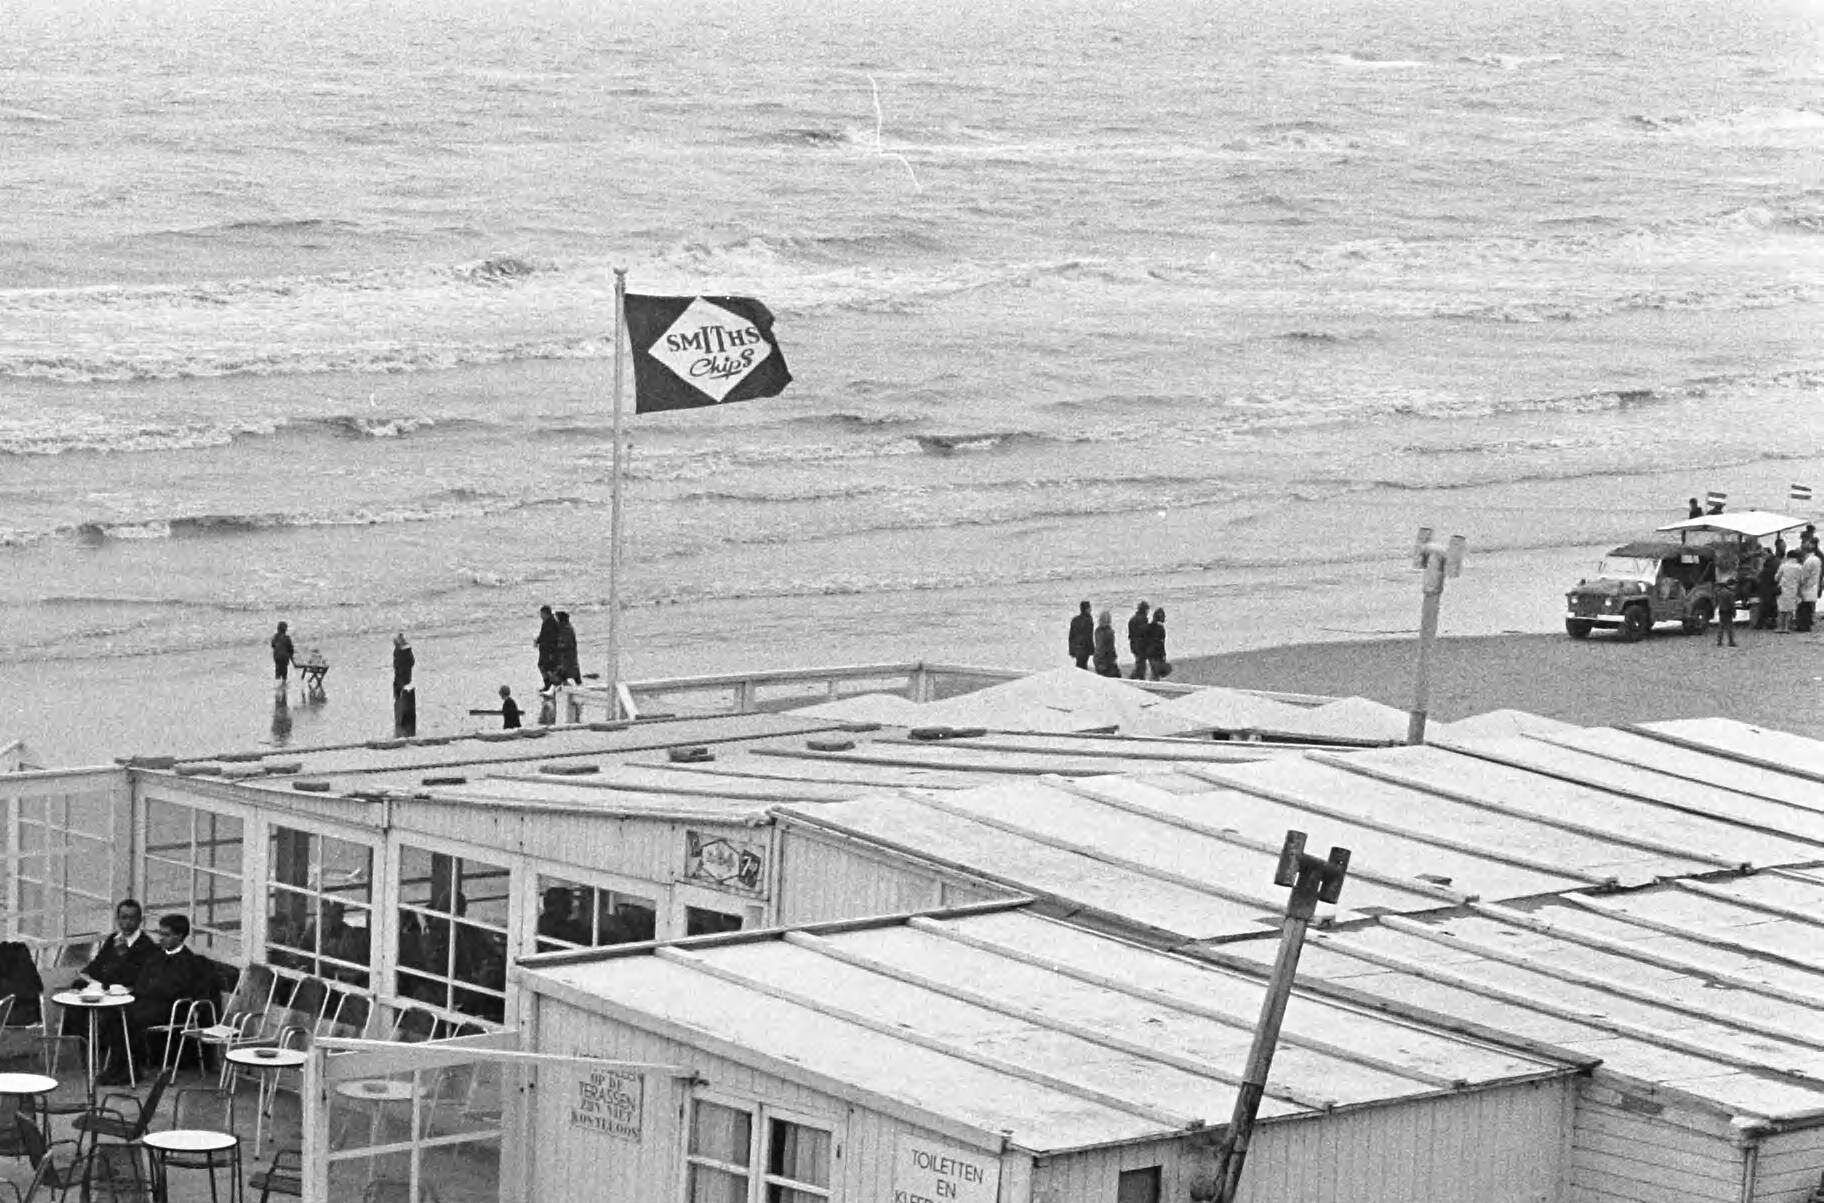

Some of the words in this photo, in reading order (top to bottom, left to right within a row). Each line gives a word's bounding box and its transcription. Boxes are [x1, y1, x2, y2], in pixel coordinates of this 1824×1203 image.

[666, 325, 761, 354] SMITHS
[689, 348, 755, 379] Chips
[912, 1149, 984, 1184] TOILETTEN
[936, 1179, 956, 1199] EN
